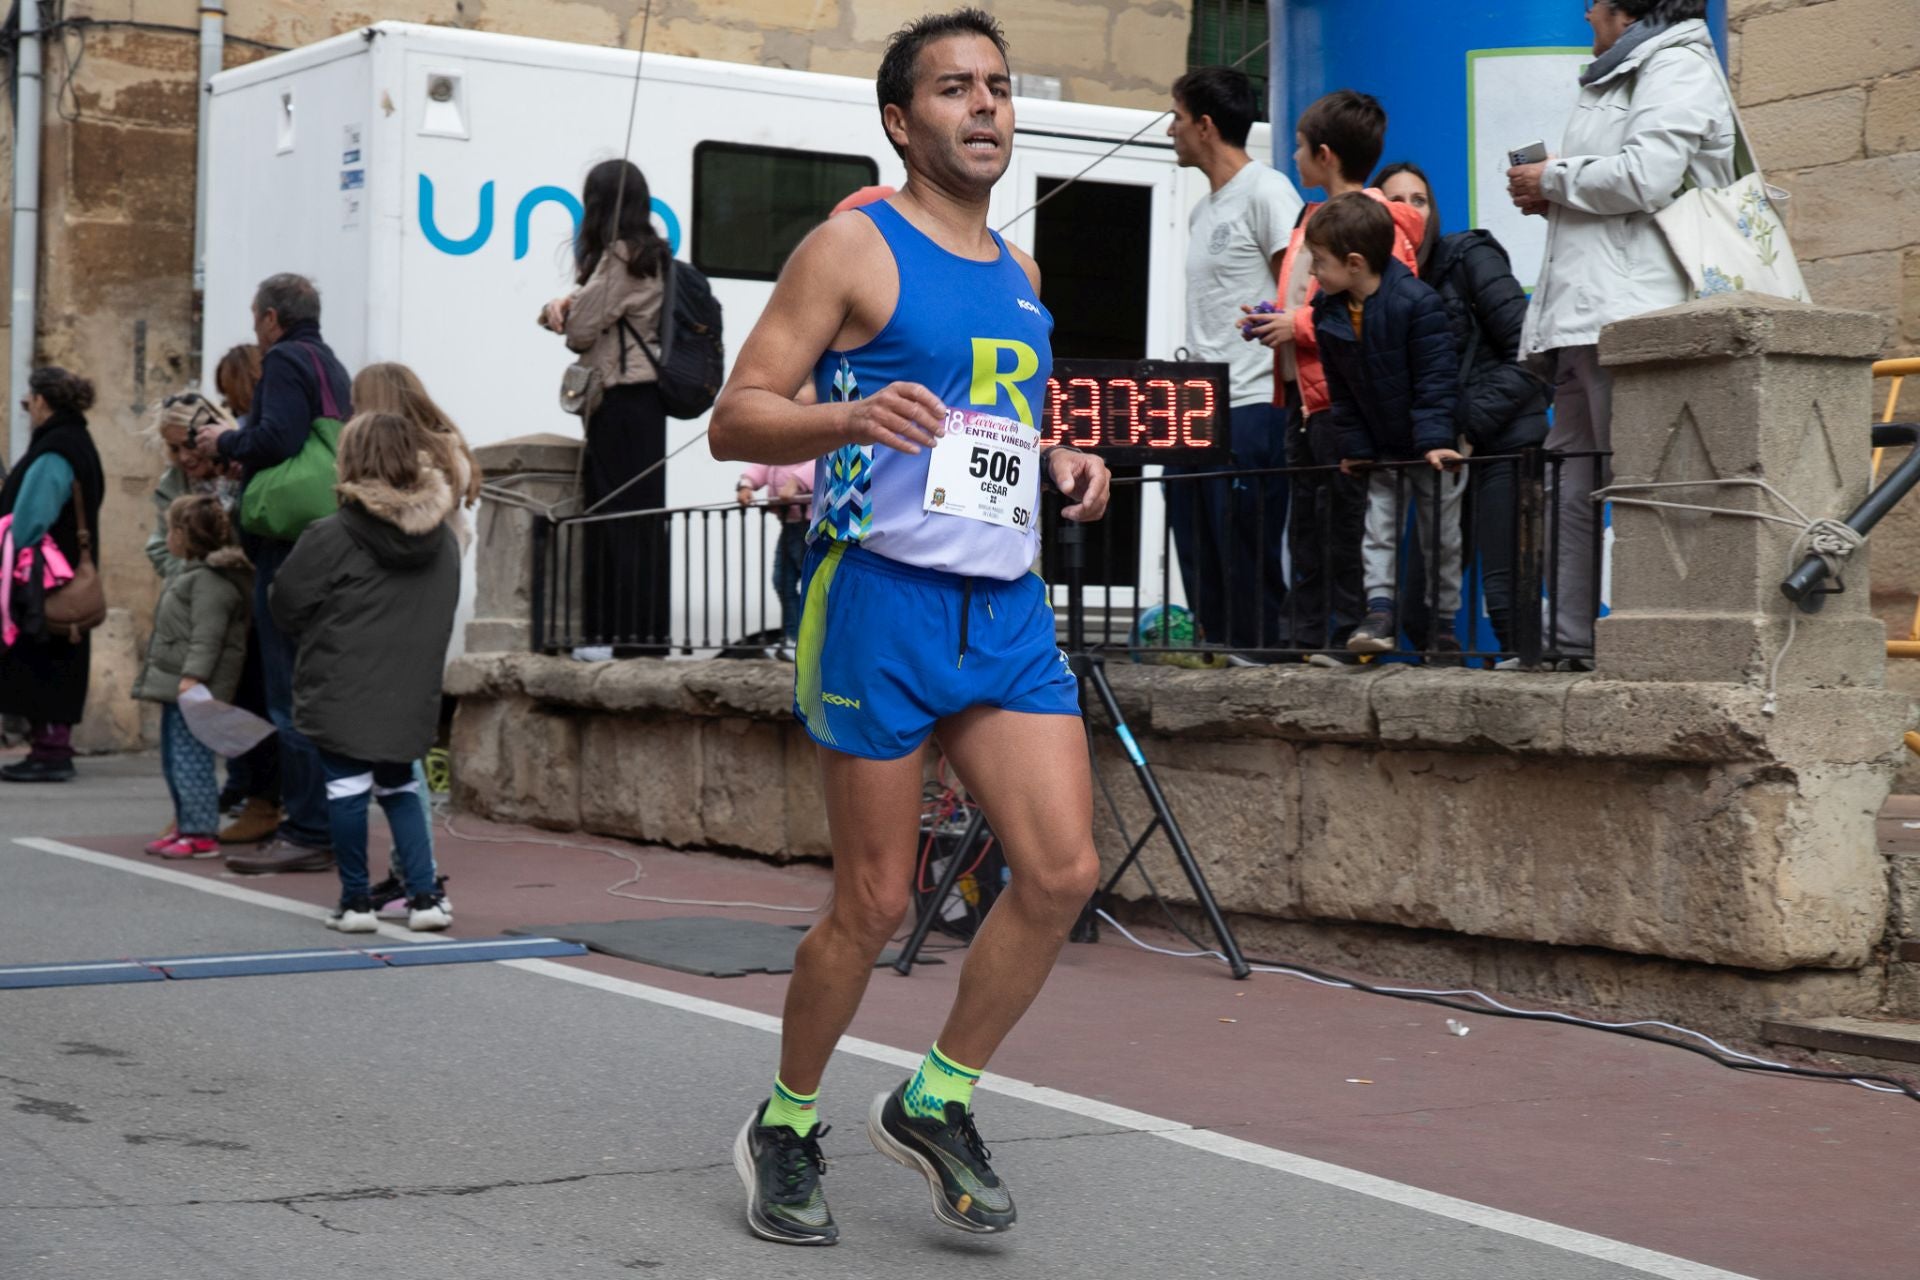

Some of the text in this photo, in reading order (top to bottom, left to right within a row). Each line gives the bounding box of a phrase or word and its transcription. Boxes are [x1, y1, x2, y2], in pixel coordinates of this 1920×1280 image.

[969, 337, 1039, 428] R
[965, 427, 998, 440] ENTRE
[969, 446, 1021, 486] 506
[980, 481, 1008, 497] CÉSAR
